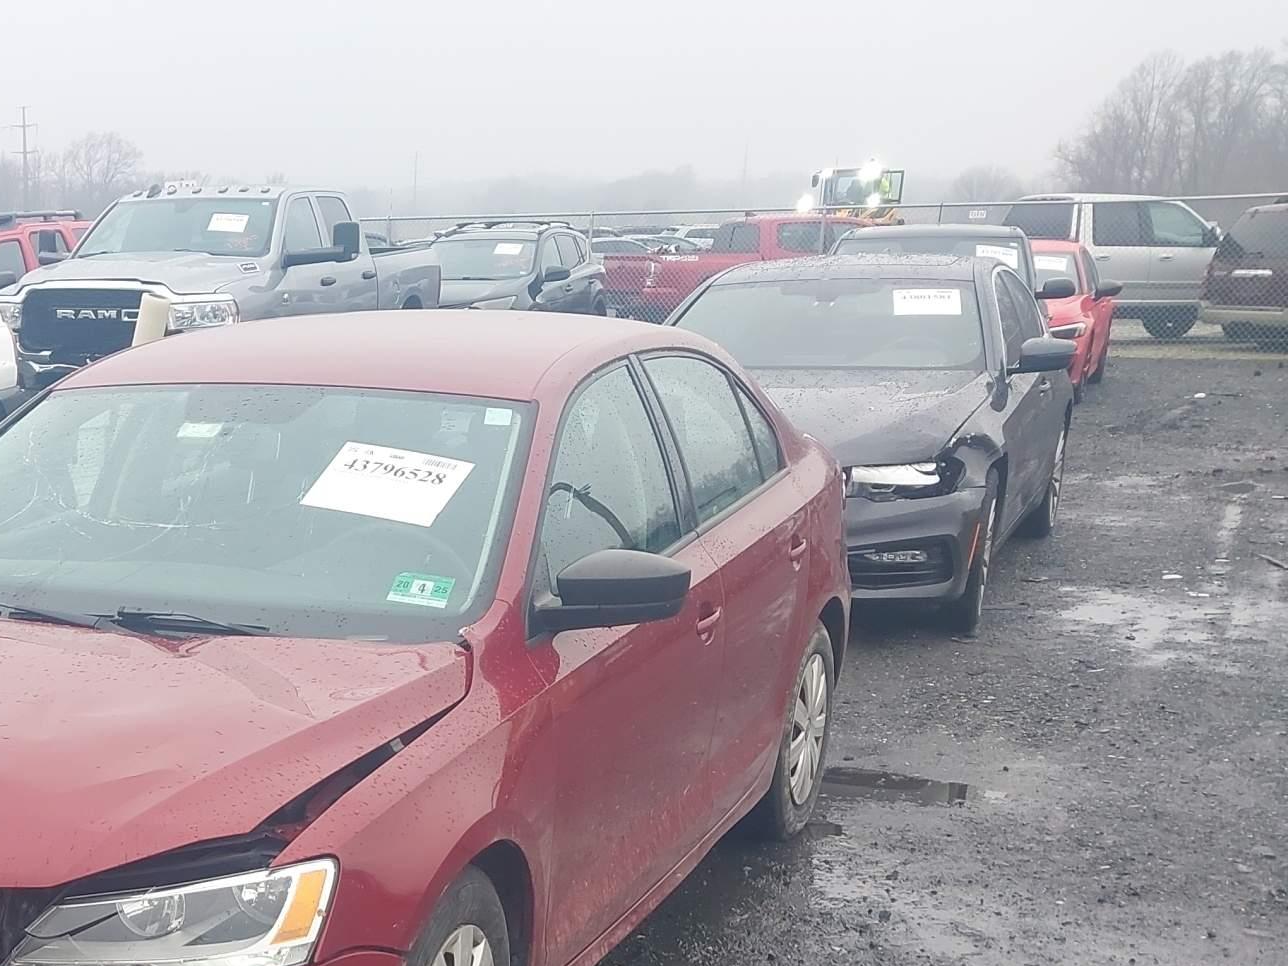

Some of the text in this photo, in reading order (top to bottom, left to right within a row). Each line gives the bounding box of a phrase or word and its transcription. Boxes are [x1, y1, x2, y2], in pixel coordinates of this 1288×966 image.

[56, 309, 118, 320] RAM
[343, 458, 448, 486] 43796528
[396, 580, 449, 594] 20 4 25
